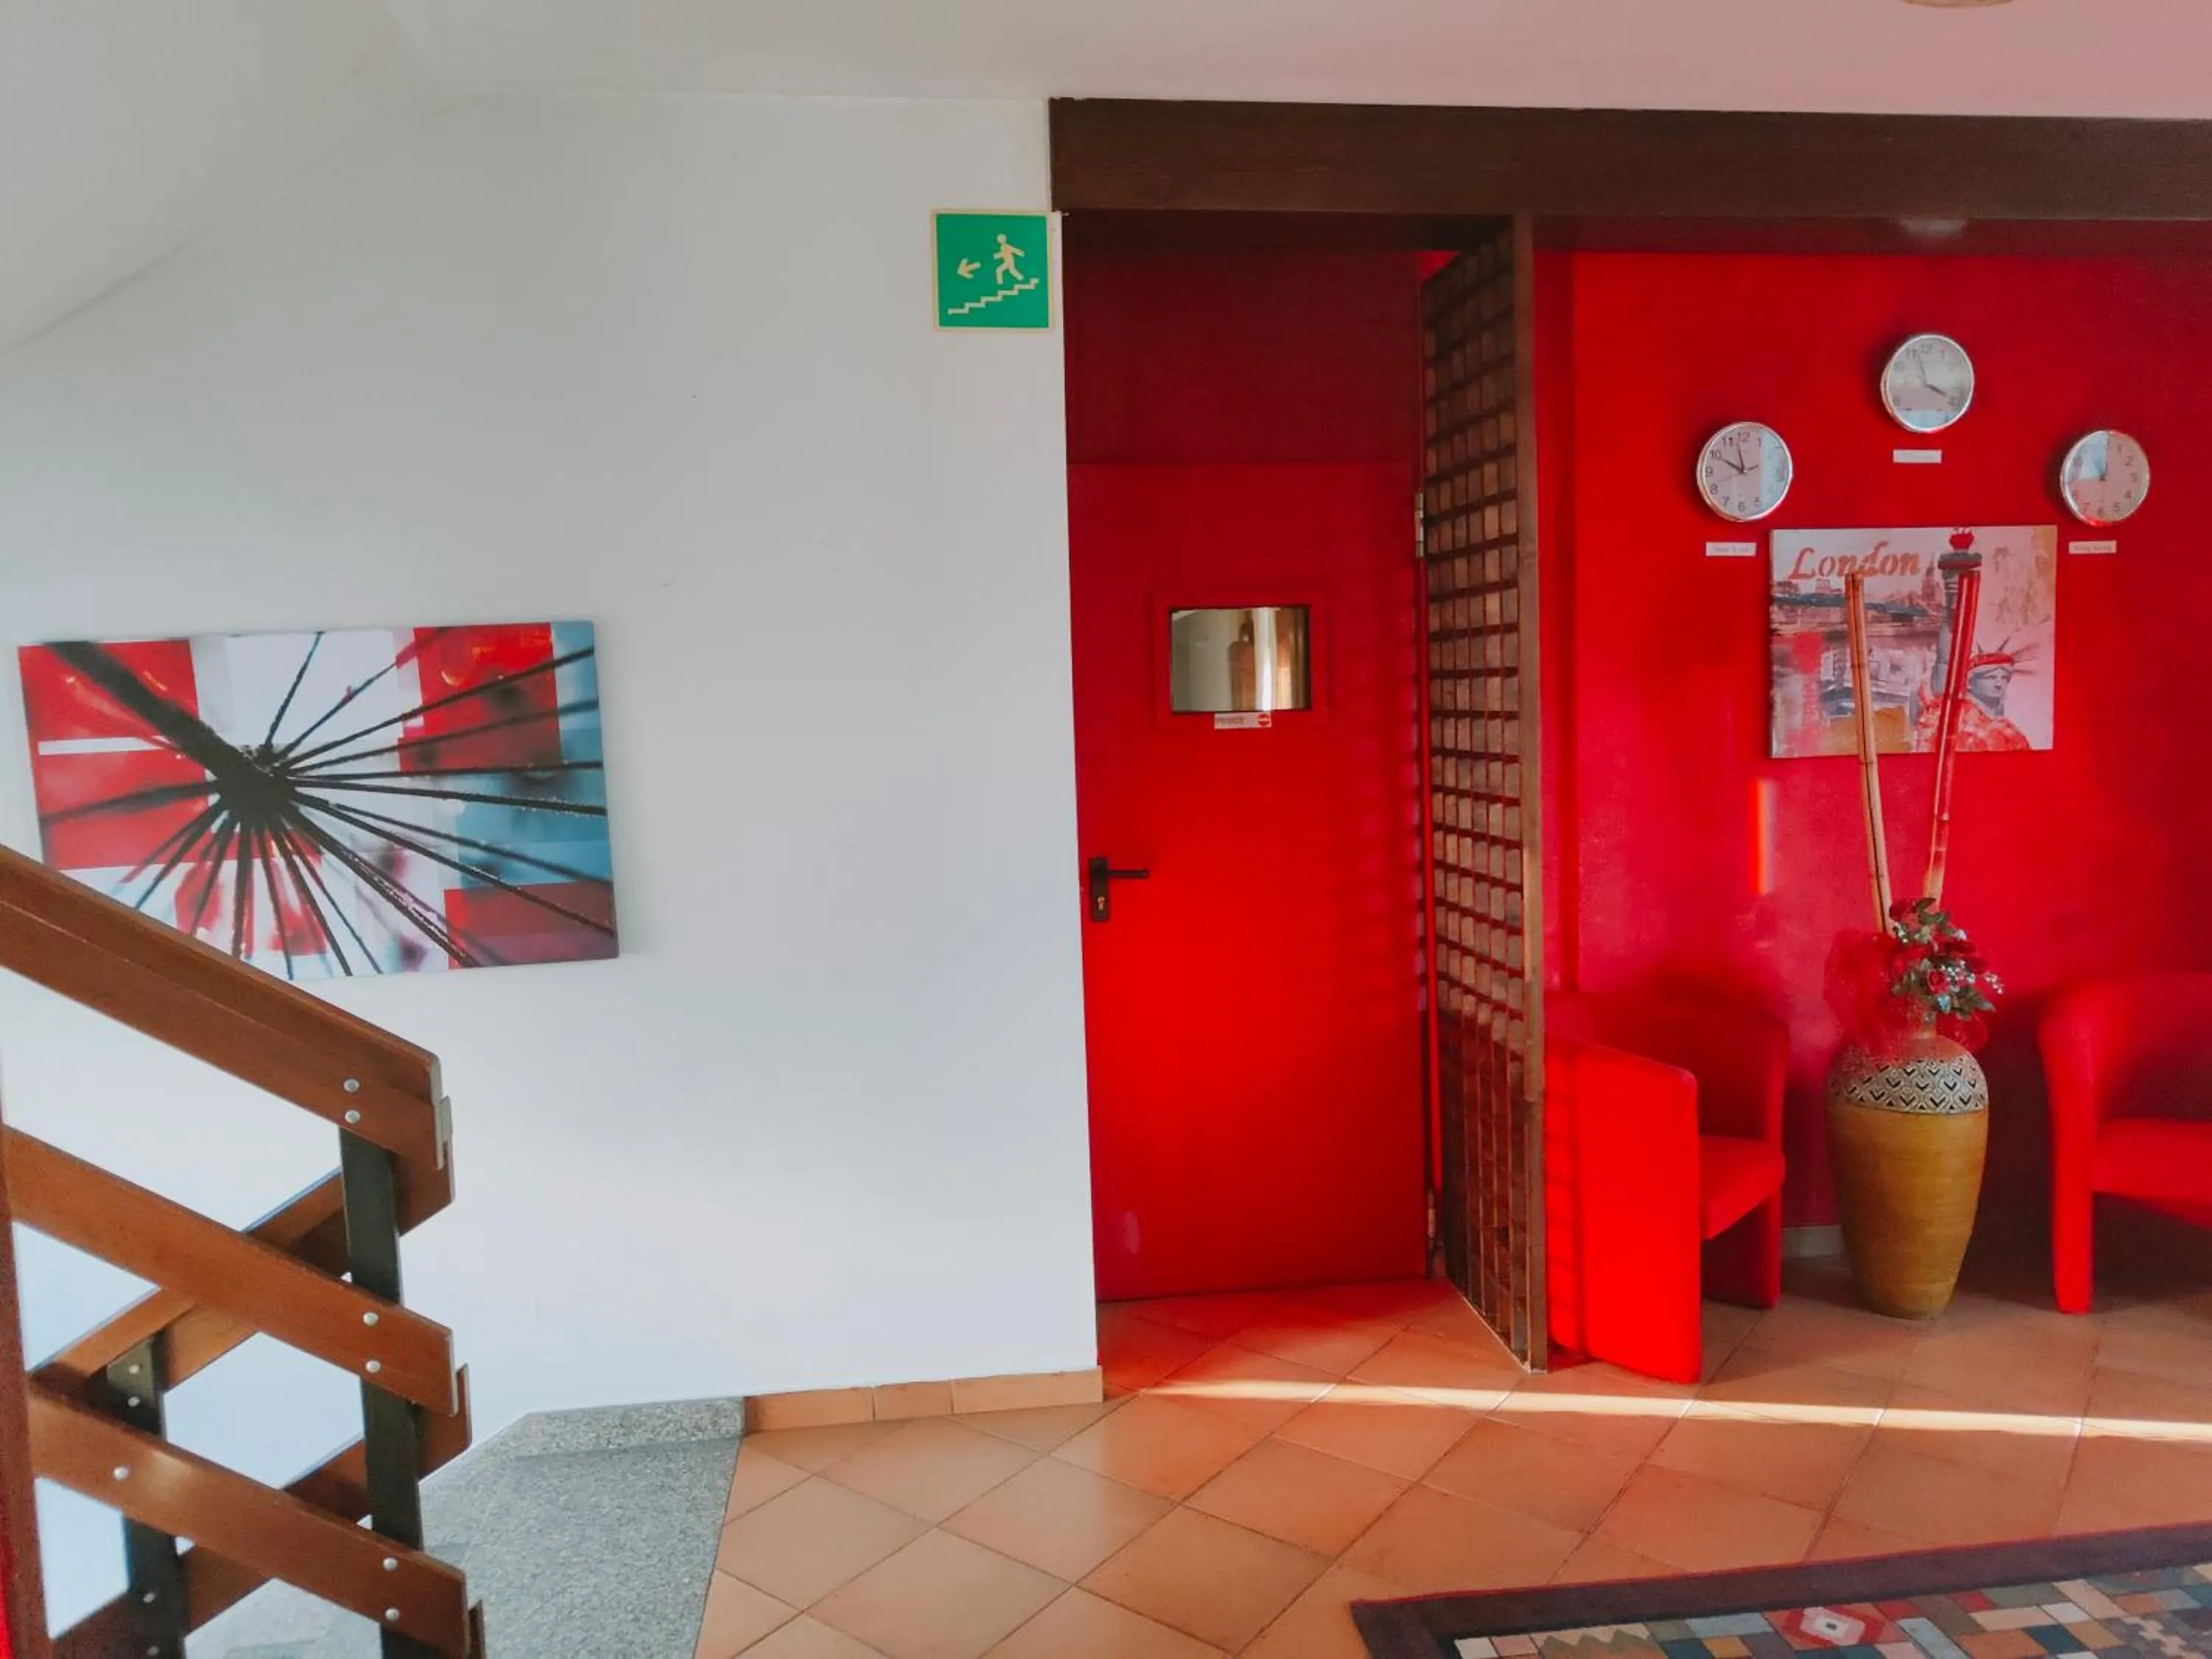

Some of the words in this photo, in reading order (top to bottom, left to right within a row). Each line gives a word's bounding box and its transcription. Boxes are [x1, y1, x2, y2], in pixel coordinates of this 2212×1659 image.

[1906, 347, 1916, 359] 11
[1738, 431, 1750, 442] 12
[1722, 437, 1733, 448] 11
[1710, 450, 1722, 460] 10
[2124, 456, 2134, 467] 2
[1705, 466, 1714, 478] 9
[2129, 473, 2138, 483] 3
[1710, 484, 1719, 495] 8
[2124, 489, 2132, 499] 4
[1722, 495, 1731, 507] 7
[1738, 500, 1746, 512] 6
[2084, 501, 2091, 512] 7
[1787, 540, 1920, 580] London
